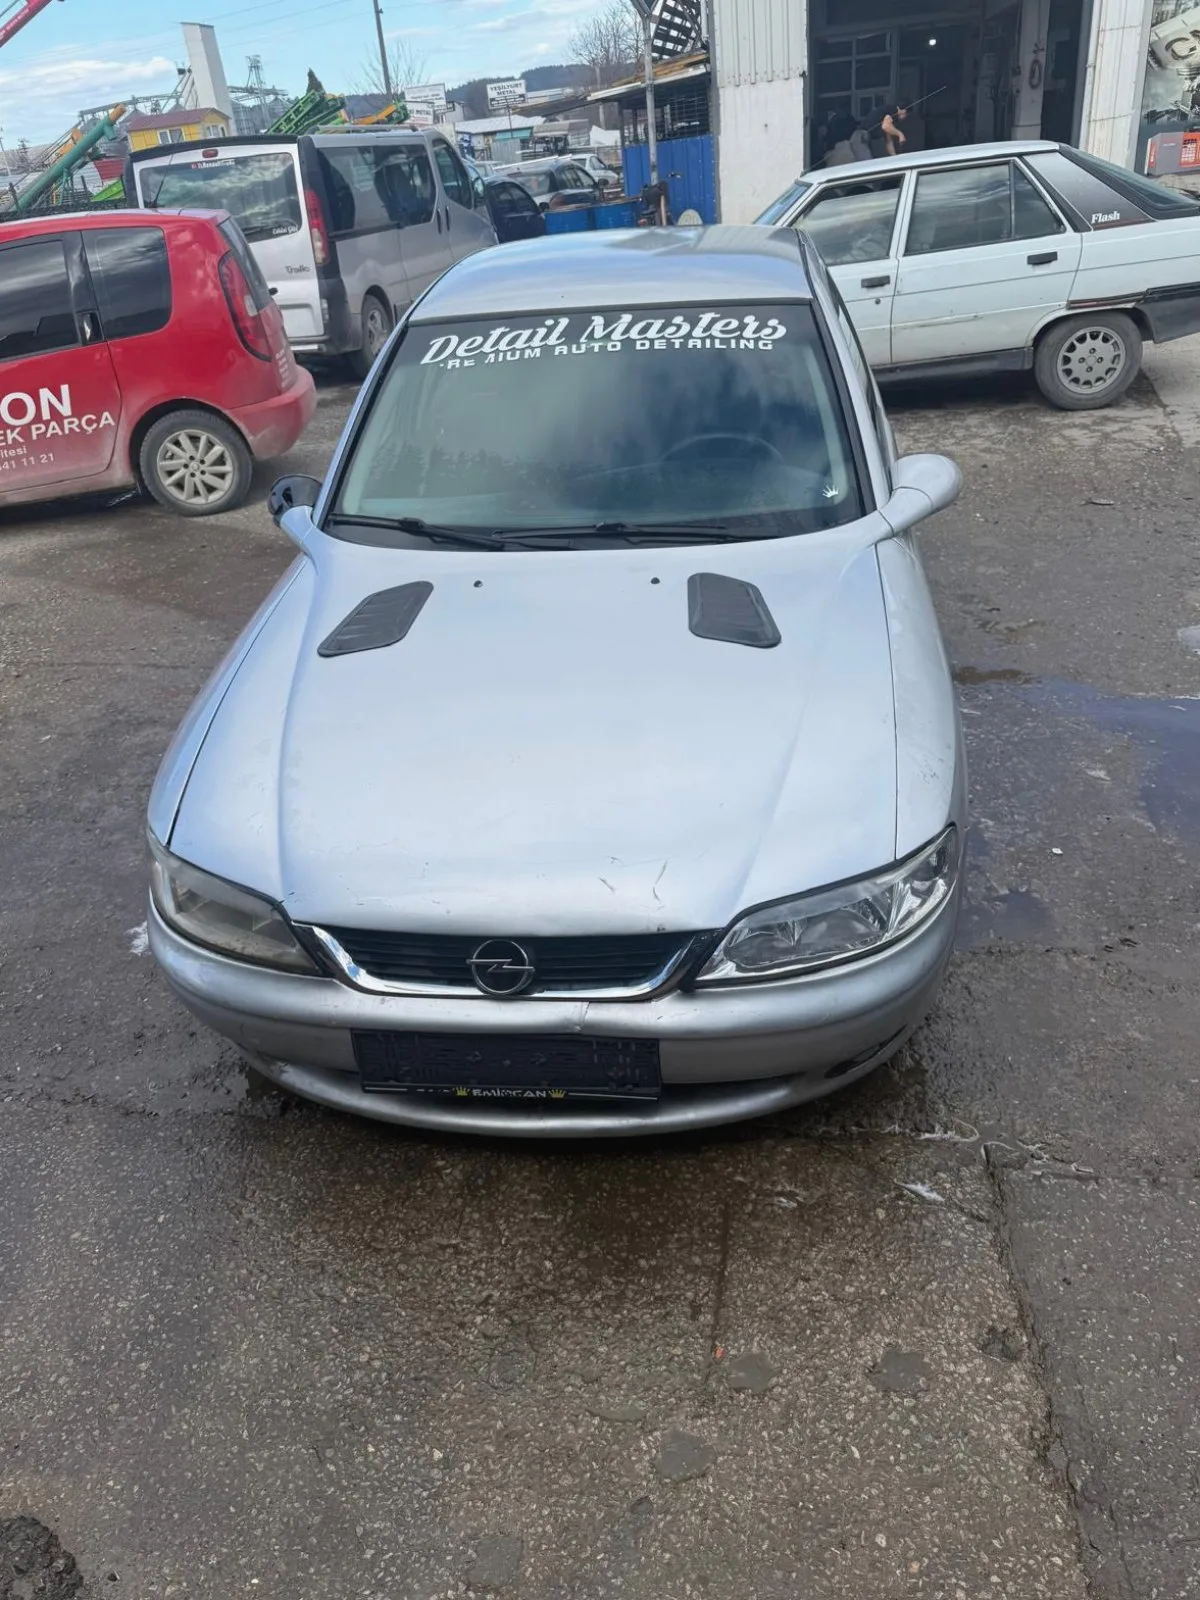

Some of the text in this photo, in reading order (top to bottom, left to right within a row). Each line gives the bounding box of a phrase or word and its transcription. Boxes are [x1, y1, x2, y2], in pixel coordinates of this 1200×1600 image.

[1091, 210, 1121, 224] Flash
[420, 312, 787, 365] Detail Masters
[554, 341, 622, 356] AUTO
[635, 338, 773, 350] DETAILING
[31, 411, 115, 440] PARÇA
[21, 457, 35, 467] 11
[40, 452, 54, 464] 21
